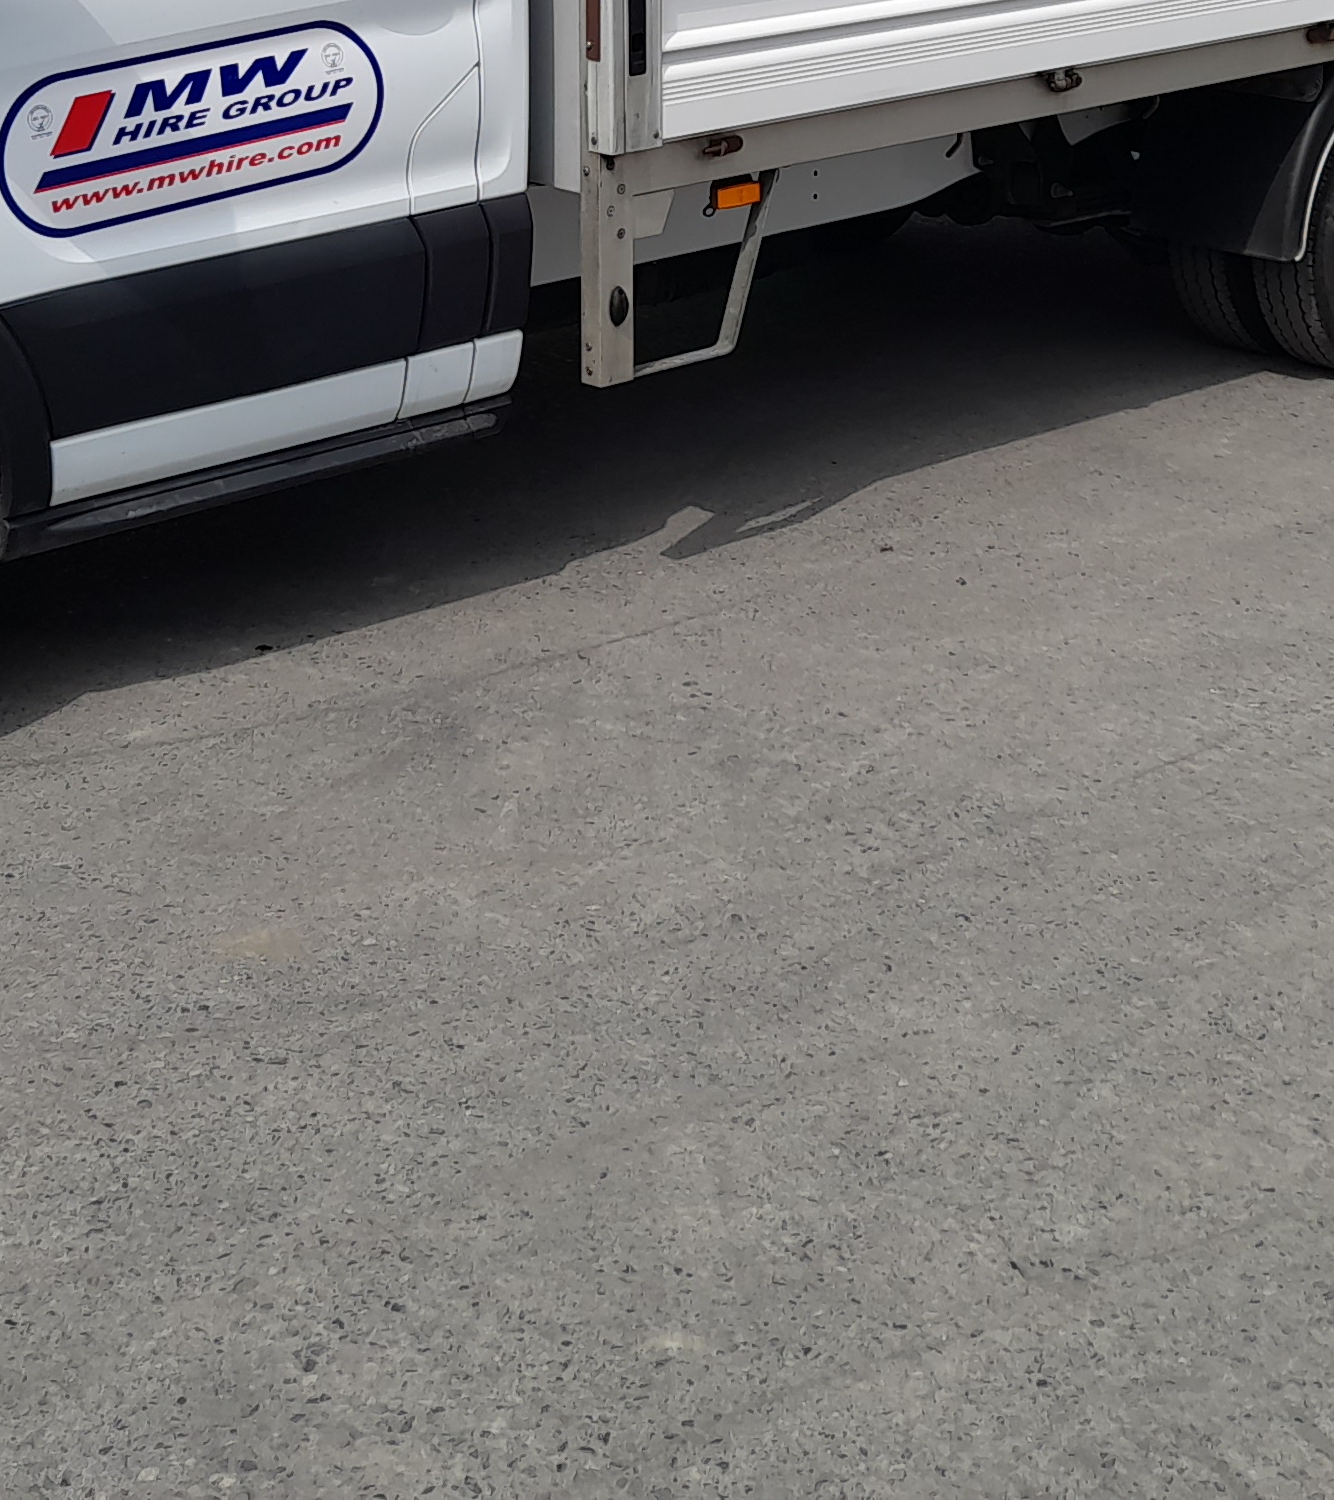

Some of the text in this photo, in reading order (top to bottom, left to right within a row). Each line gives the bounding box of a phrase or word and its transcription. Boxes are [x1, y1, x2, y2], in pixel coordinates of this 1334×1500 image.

[112, 76, 354, 146] HIRE GROUP
[123, 48, 309, 120] MW
[50, 134, 342, 214] www.mwhire.com
